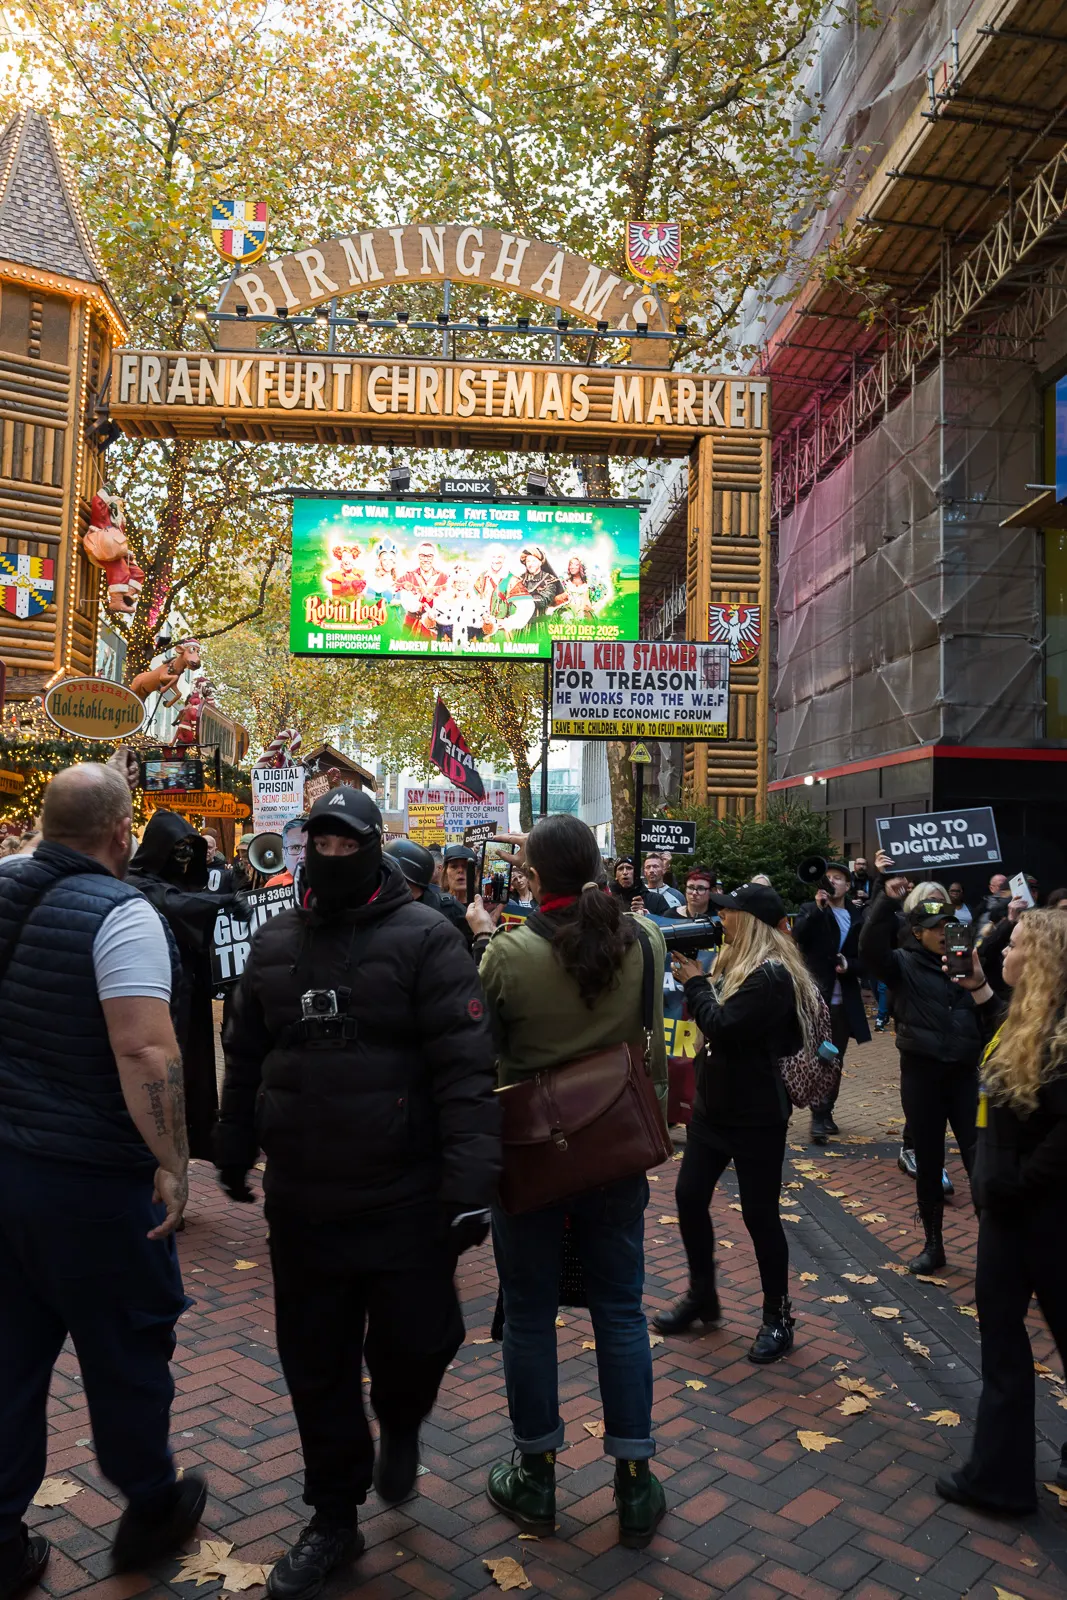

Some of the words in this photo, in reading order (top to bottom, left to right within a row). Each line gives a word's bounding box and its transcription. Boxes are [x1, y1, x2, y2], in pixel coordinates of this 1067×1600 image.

[235, 226, 658, 331] BIRMINGHAM'S
[120, 355, 351, 411] FRANKFURT
[367, 364, 589, 422] CHRISTMAS
[610, 375, 767, 428] MARKET
[444, 482, 490, 493] ELONEX
[395, 506, 423, 519] MATT
[423, 507, 457, 520] SLACK
[464, 507, 488, 521] FAYE
[489, 508, 520, 522] TOZER
[527, 509, 554, 523] MATT
[555, 510, 593, 524] CARDLE
[305, 596, 348, 623] Robin
[349, 597, 388, 626] Hood
[326, 633, 381, 642] BIRMINGHAM
[548, 624, 563, 635] SAT
[565, 624, 577, 635] 20
[580, 625, 596, 636] DEC
[597, 625, 619, 637] 2025
[325, 641, 381, 650] HIPPODROME
[555, 643, 586, 670] JAIL
[594, 643, 626, 671] KEIR
[633, 644, 697, 672] STARMER
[555, 671, 594, 689] FOR
[606, 672, 697, 691] TREASON
[66, 682, 129, 702] Original
[556, 691, 572, 705] HE
[579, 691, 623, 706] WORKS
[631, 692, 654, 706] FOR
[661, 693, 684, 706] THE
[692, 693, 725, 707] W.E.F
[53, 692, 139, 729] Holzkohlengrill
[569, 707, 609, 719] WORLD
[613, 708, 670, 720] ECONOMIC
[674, 709, 712, 720] FORUM
[555, 721, 571, 734] SAVE
[574, 722, 585, 734] THE
[622, 722, 634, 735] SAY
[636, 723, 647, 735] NO
[648, 723, 657, 735] TO
[658, 723, 675, 736] (FLU)
[676, 723, 694, 736] mRNA
[696, 724, 725, 737] VACCINES
[253, 770, 260, 781] A
[263, 769, 299, 781] DIGITAL
[259, 781, 294, 793] PRISON
[262, 794, 280, 804] BEING
[282, 793, 300, 803] BUILT
[408, 790, 424, 804] SAY
[444, 791, 455, 805] TO
[495, 791, 504, 805] ID
[472, 827, 481, 835] NO
[651, 825, 667, 834] NO
[669, 825, 683, 835] TO
[909, 822, 938, 837] NO
[941, 819, 968, 834] TO
[465, 833, 487, 843] DIGITAL
[487, 832, 494, 840] ID
[641, 834, 678, 844] DIGITAL
[680, 836, 690, 845] ID
[890, 835, 965, 856] DIGITAL
[967, 833, 988, 847] ID
